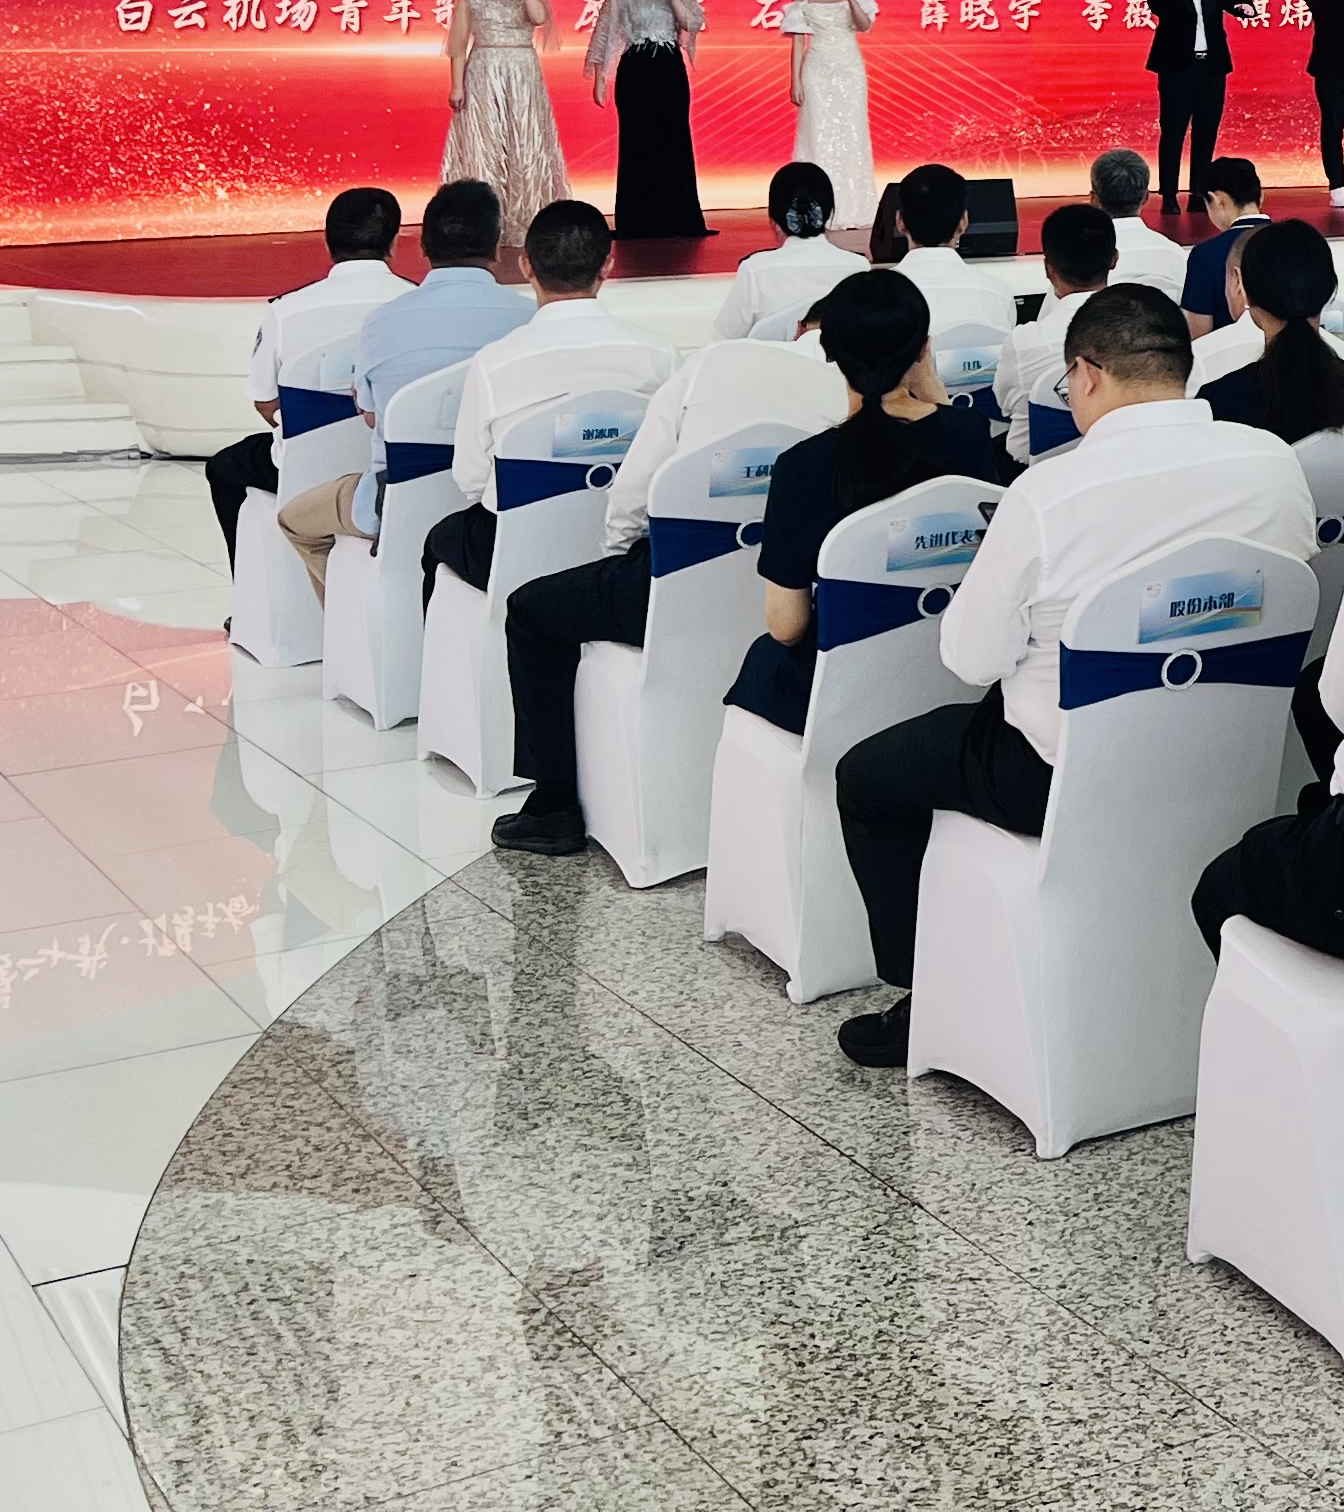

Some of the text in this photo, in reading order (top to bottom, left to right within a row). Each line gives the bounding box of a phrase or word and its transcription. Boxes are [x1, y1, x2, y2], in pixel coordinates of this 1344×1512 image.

[914, 529, 975, 551] 先进代表
[1169, 592, 1236, 618] 股份本部
